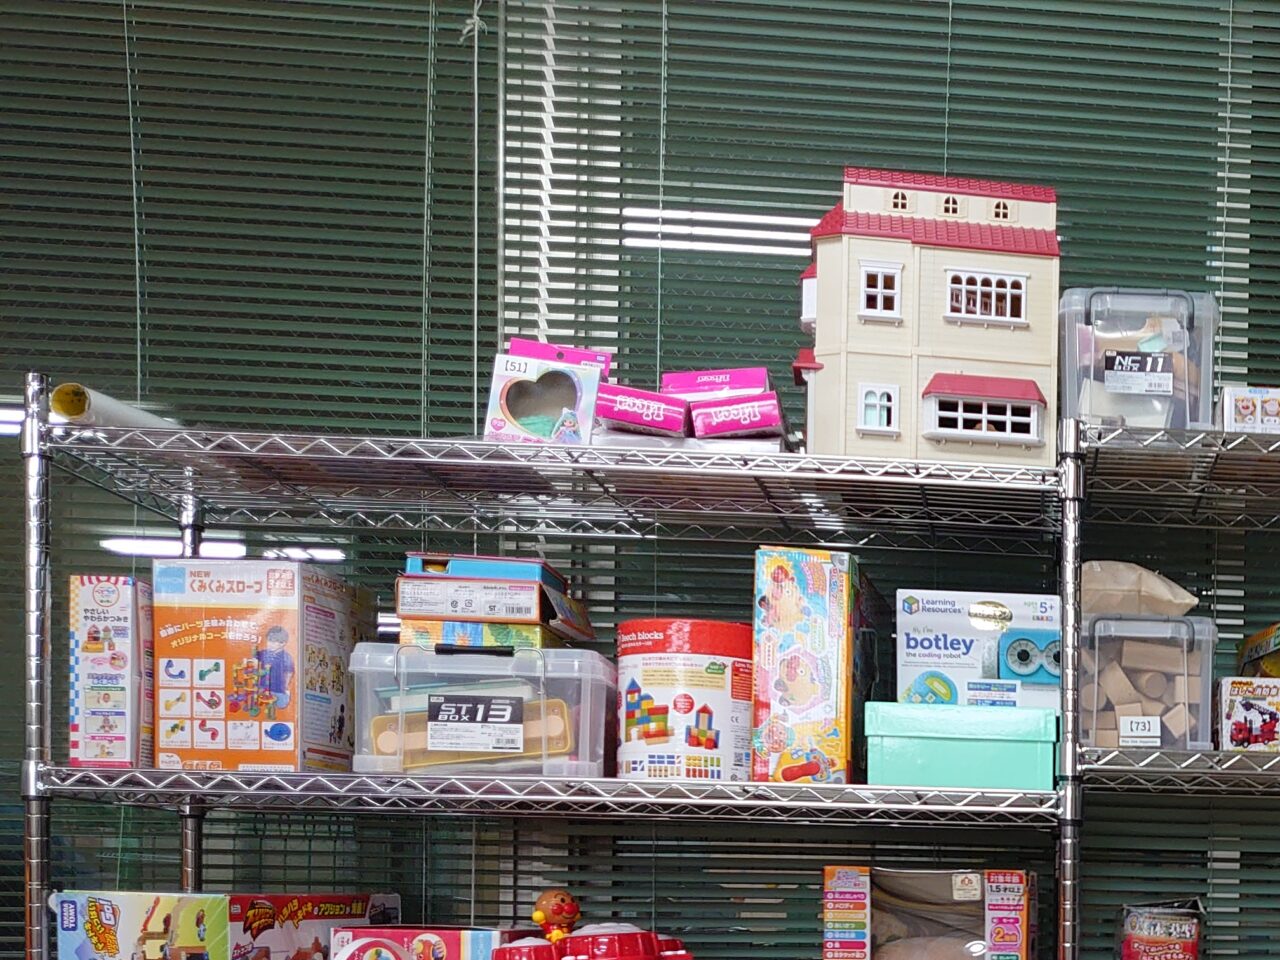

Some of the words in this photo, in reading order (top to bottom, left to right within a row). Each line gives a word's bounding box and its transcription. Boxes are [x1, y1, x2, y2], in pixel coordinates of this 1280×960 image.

[504, 360, 528, 373] 【51】
[1146, 356, 1164, 372] 11
[614, 395, 666, 421] Licca
[712, 402, 760, 425] Licca
[190, 570, 211, 578] NEW
[921, 598, 956, 607] Learning
[921, 606, 962, 614] Resources
[637, 631, 664, 641] blocks
[905, 632, 975, 656] botley
[918, 652, 942, 660] coding
[438, 714, 471, 722] BOX
[439, 702, 473, 715] ST
[474, 702, 513, 722] 13
[1130, 720, 1151, 732] 【73】
